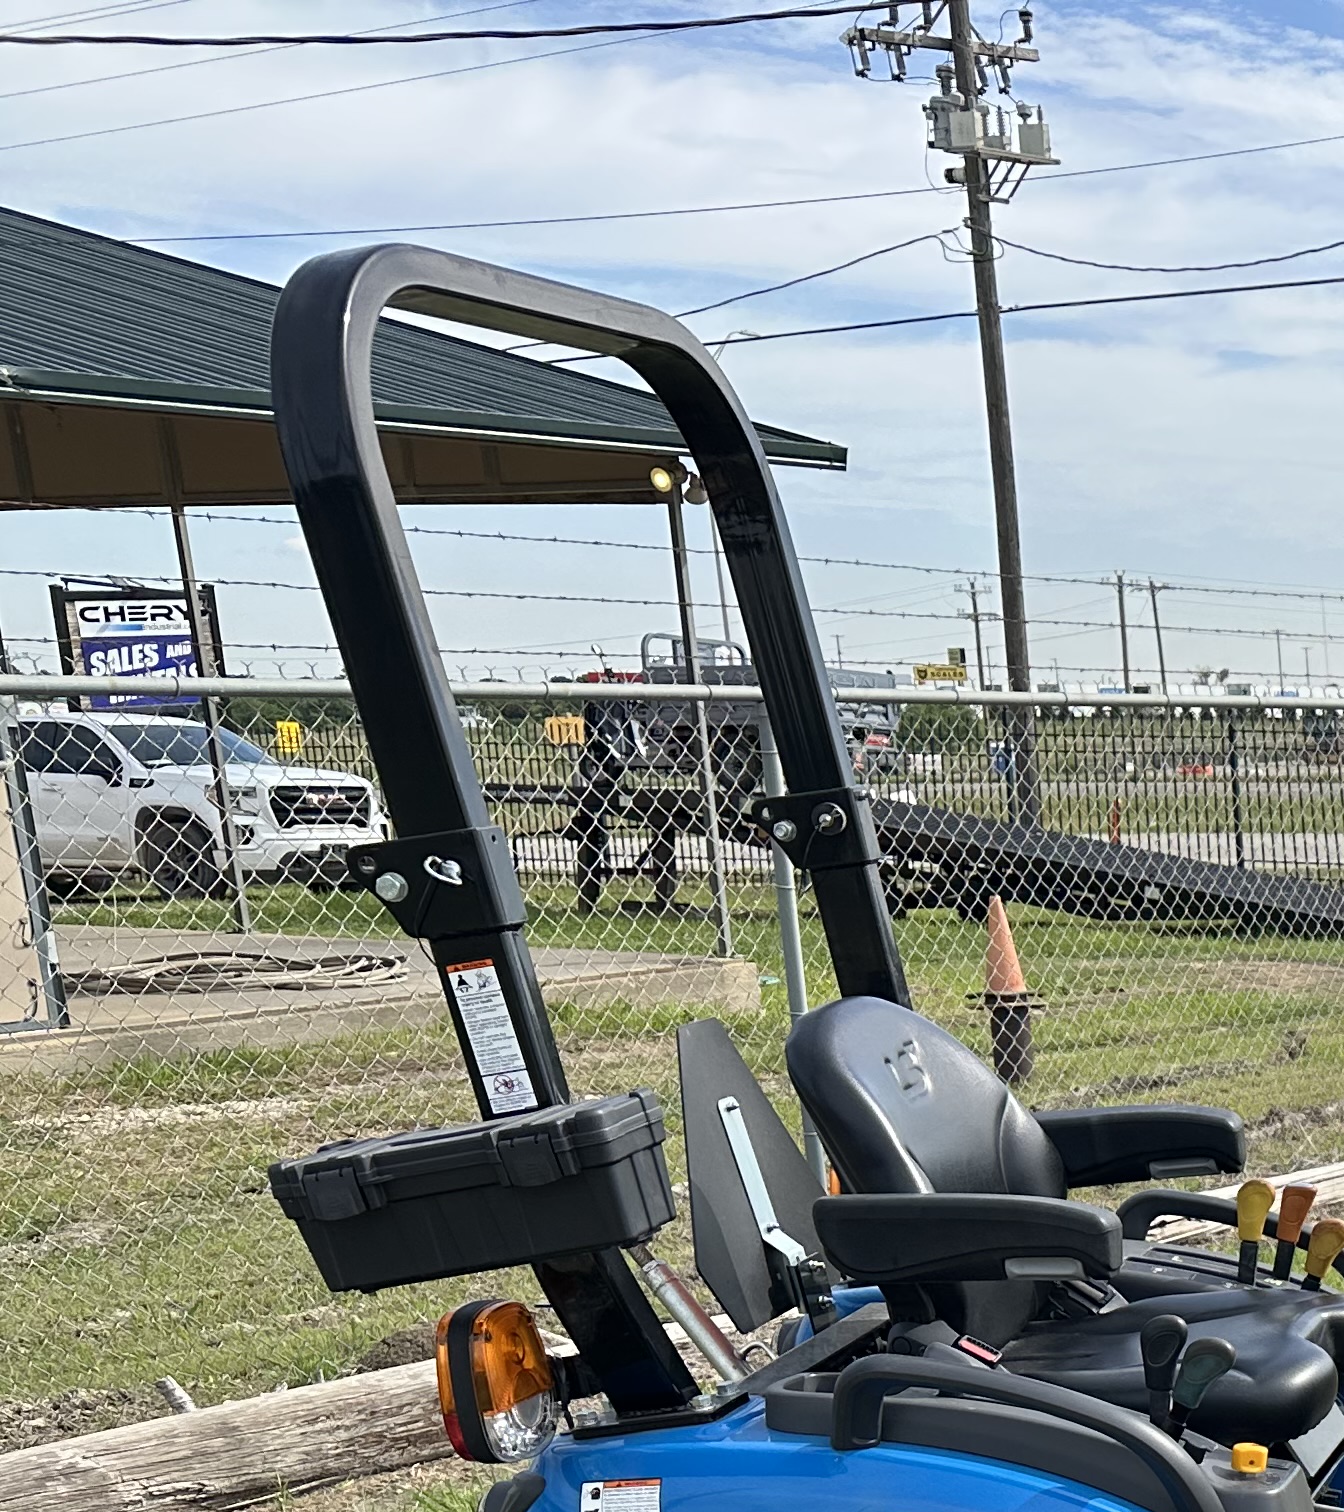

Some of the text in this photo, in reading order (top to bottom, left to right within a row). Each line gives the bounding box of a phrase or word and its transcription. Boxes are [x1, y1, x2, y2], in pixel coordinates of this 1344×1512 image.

[79, 605, 190, 623] CHERY
[90, 641, 192, 677] SALES AND
